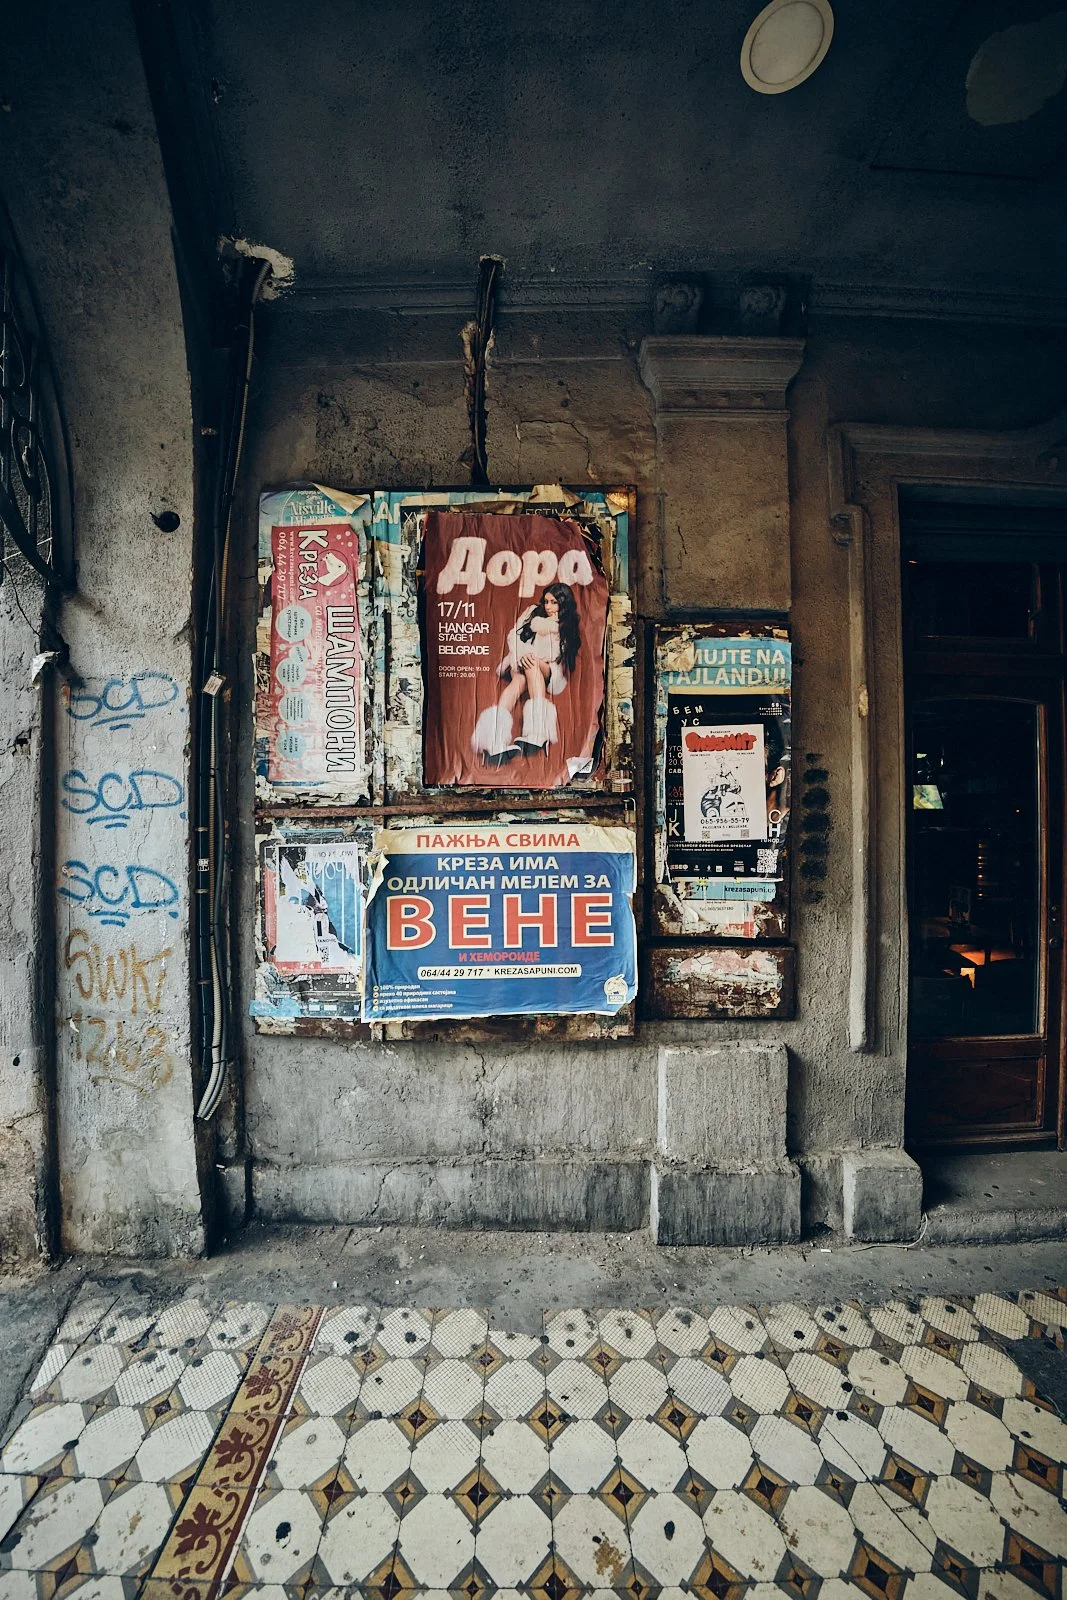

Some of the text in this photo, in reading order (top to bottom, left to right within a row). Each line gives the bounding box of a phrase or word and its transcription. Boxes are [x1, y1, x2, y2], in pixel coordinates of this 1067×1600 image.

[277, 532, 287, 600] 064 44 29 717
[436, 536, 594, 598] Дора
[437, 600, 475, 619] 17/11
[438, 622, 490, 634] HANGAR
[438, 633, 474, 642] STAGE 1
[438, 645, 490, 655] BELGRADE
[756, 649, 786, 665] NA
[326, 605, 356, 772] ШАМПОНИ
[416, 833, 581, 848] ПАЖЊА СВИМА
[437, 856, 560, 871] КРЕЗА ИМА
[387, 874, 612, 893] ОДЛИЧАН МЕЛЕМ ЗА
[387, 893, 614, 950] ВЕНЕ
[458, 951, 541, 963] И ХЕМОРОИДЕ
[420, 968, 451, 978] 064/44
[453, 968, 465, 977] 29
[467, 967, 484, 977] 717
[494, 966, 578, 976] KREZASAPUNI.COM
